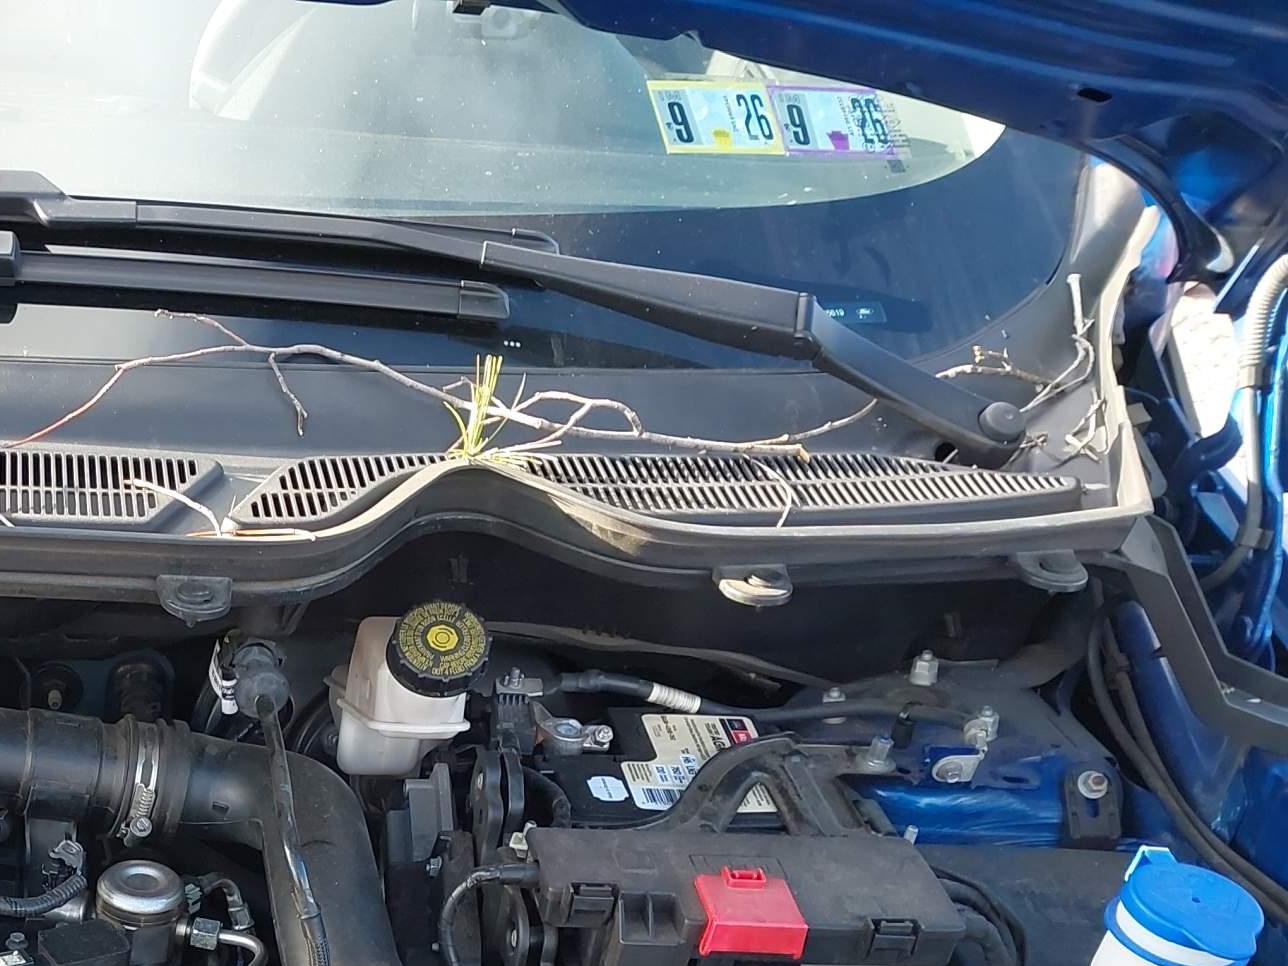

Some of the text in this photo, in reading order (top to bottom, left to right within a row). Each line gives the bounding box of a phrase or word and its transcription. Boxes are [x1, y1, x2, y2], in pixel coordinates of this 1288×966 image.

[667, 101, 694, 143] 9
[736, 93, 773, 141] 26
[786, 104, 810, 145] 9
